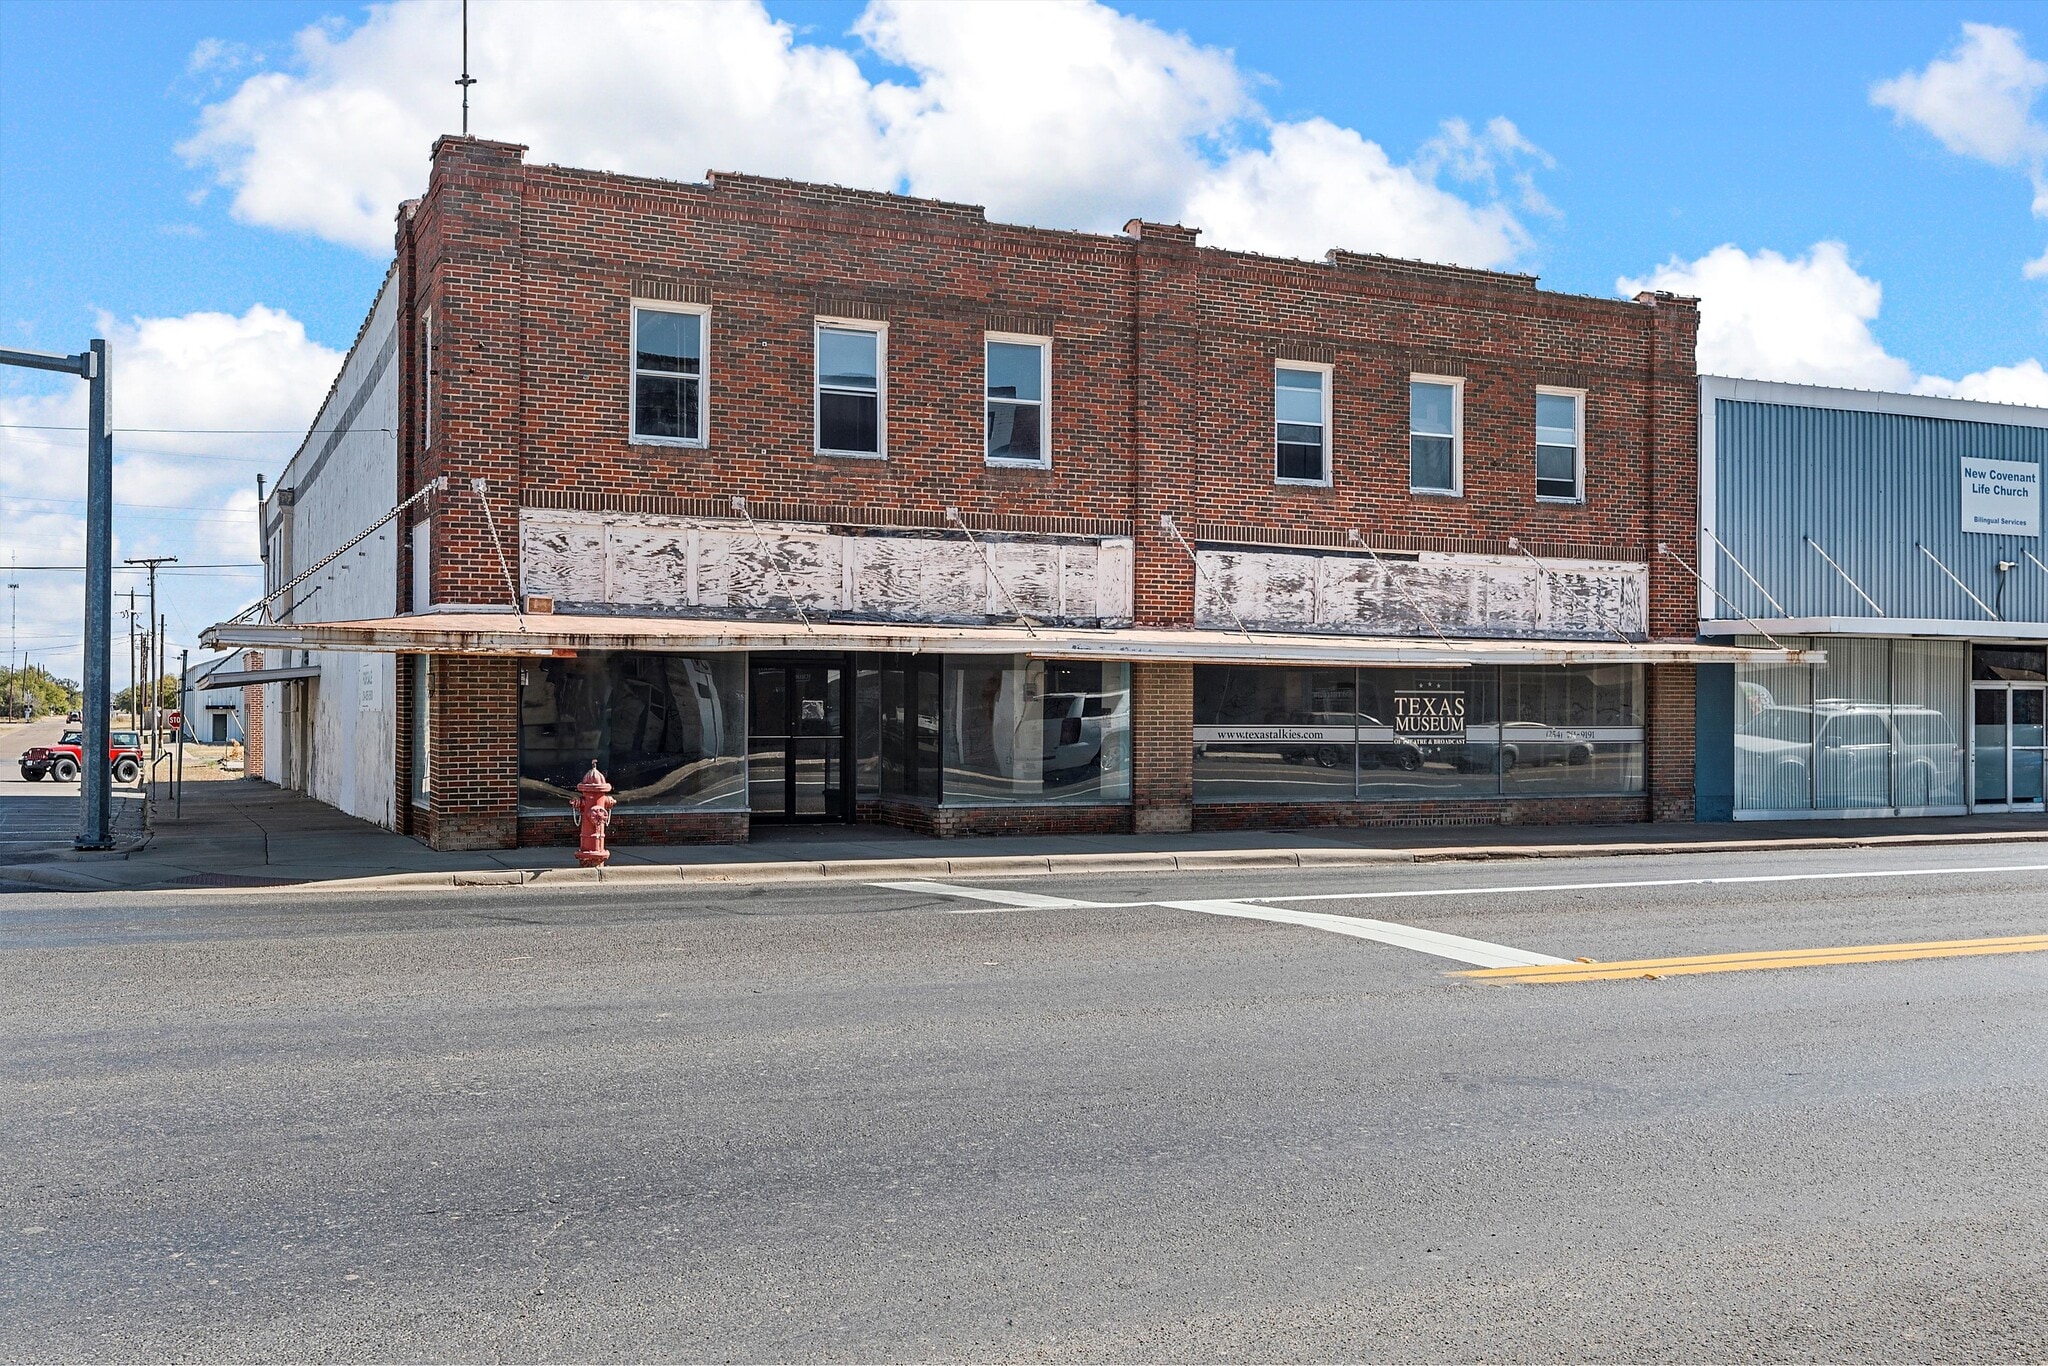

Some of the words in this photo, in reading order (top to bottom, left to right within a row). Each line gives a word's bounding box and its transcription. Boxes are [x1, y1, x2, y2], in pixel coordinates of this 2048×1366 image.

[1964, 467, 1986, 479] New
[1989, 469, 2036, 483] Covenant
[1972, 483, 1990, 495] Life
[1993, 485, 2029, 497] Church
[1973, 516, 2000, 525] Bilingual
[2000, 517, 2027, 526] Services
[1394, 697, 1465, 716] TEXAS
[169, 716, 181, 724] STO
[1394, 716, 1465, 732] MUSEUM
[1217, 728, 1324, 739] www.texastalkies.com
